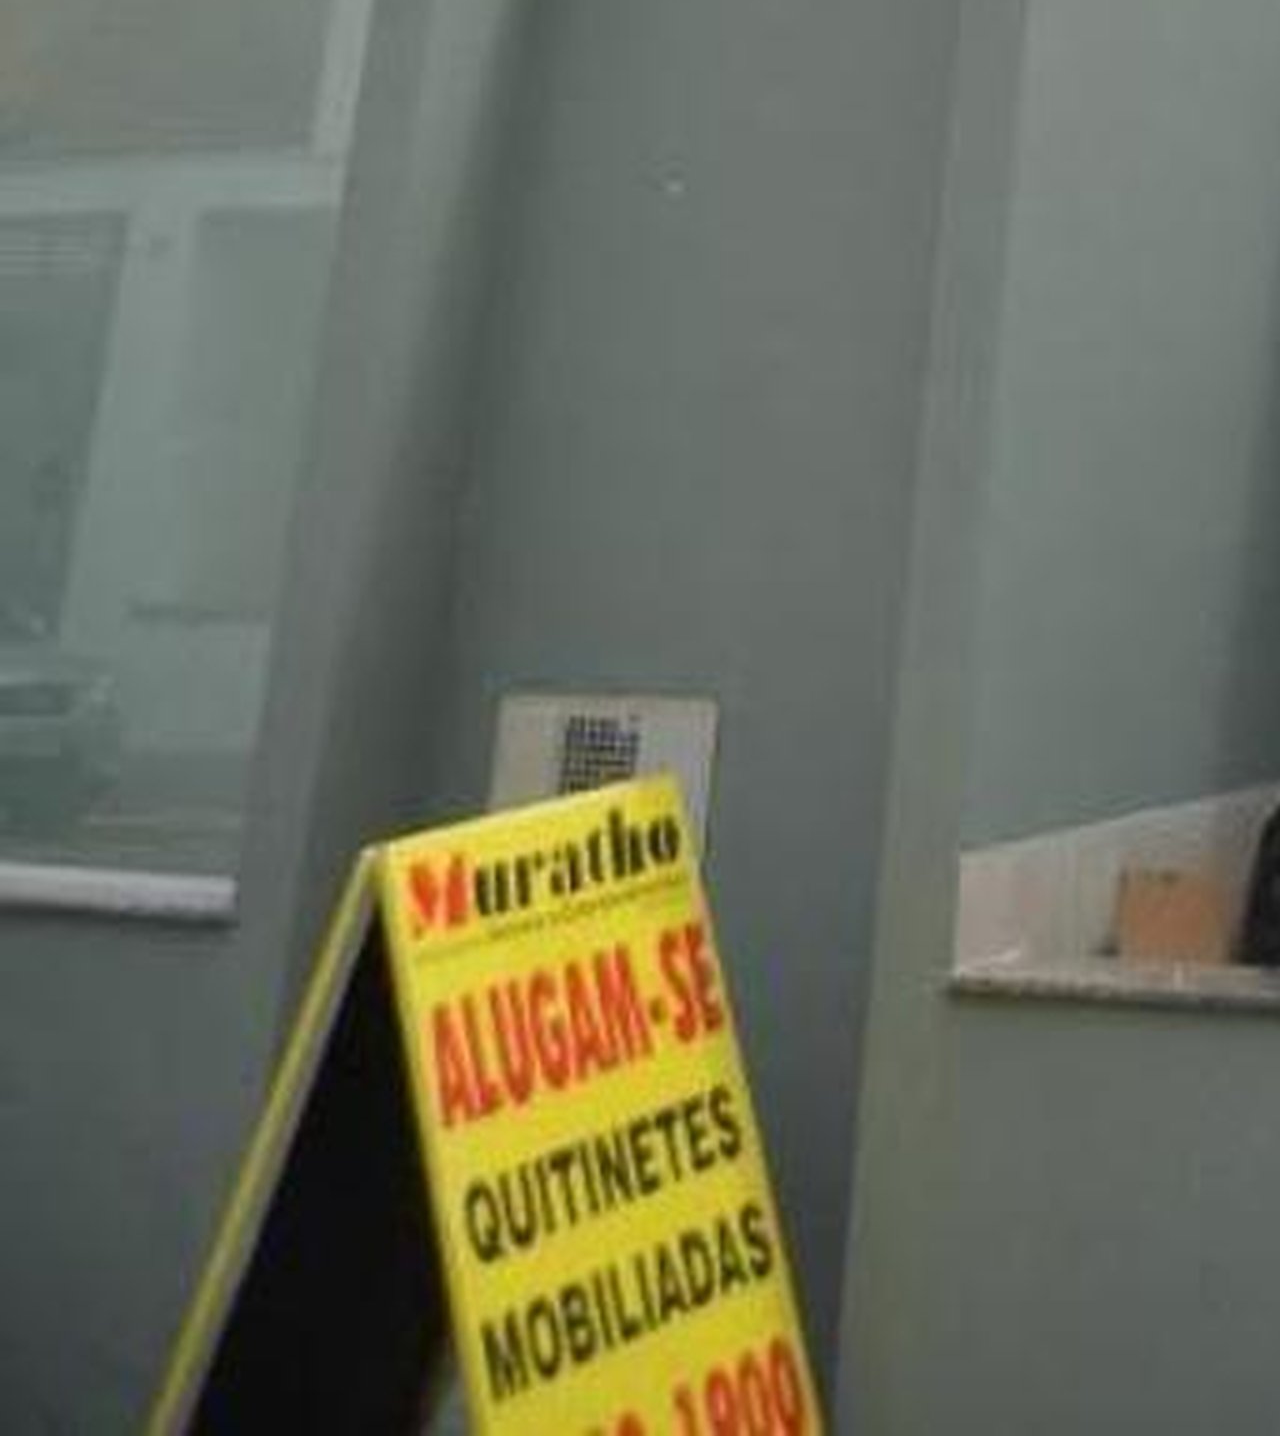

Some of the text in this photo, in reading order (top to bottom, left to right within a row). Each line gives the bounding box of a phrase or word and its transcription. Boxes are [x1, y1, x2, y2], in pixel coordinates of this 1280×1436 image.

[430, 921, 722, 1128] ALUGAM-SE
[463, 1085, 744, 1263] QUITINETES
[480, 1204, 775, 1400] MOBILIADAS
